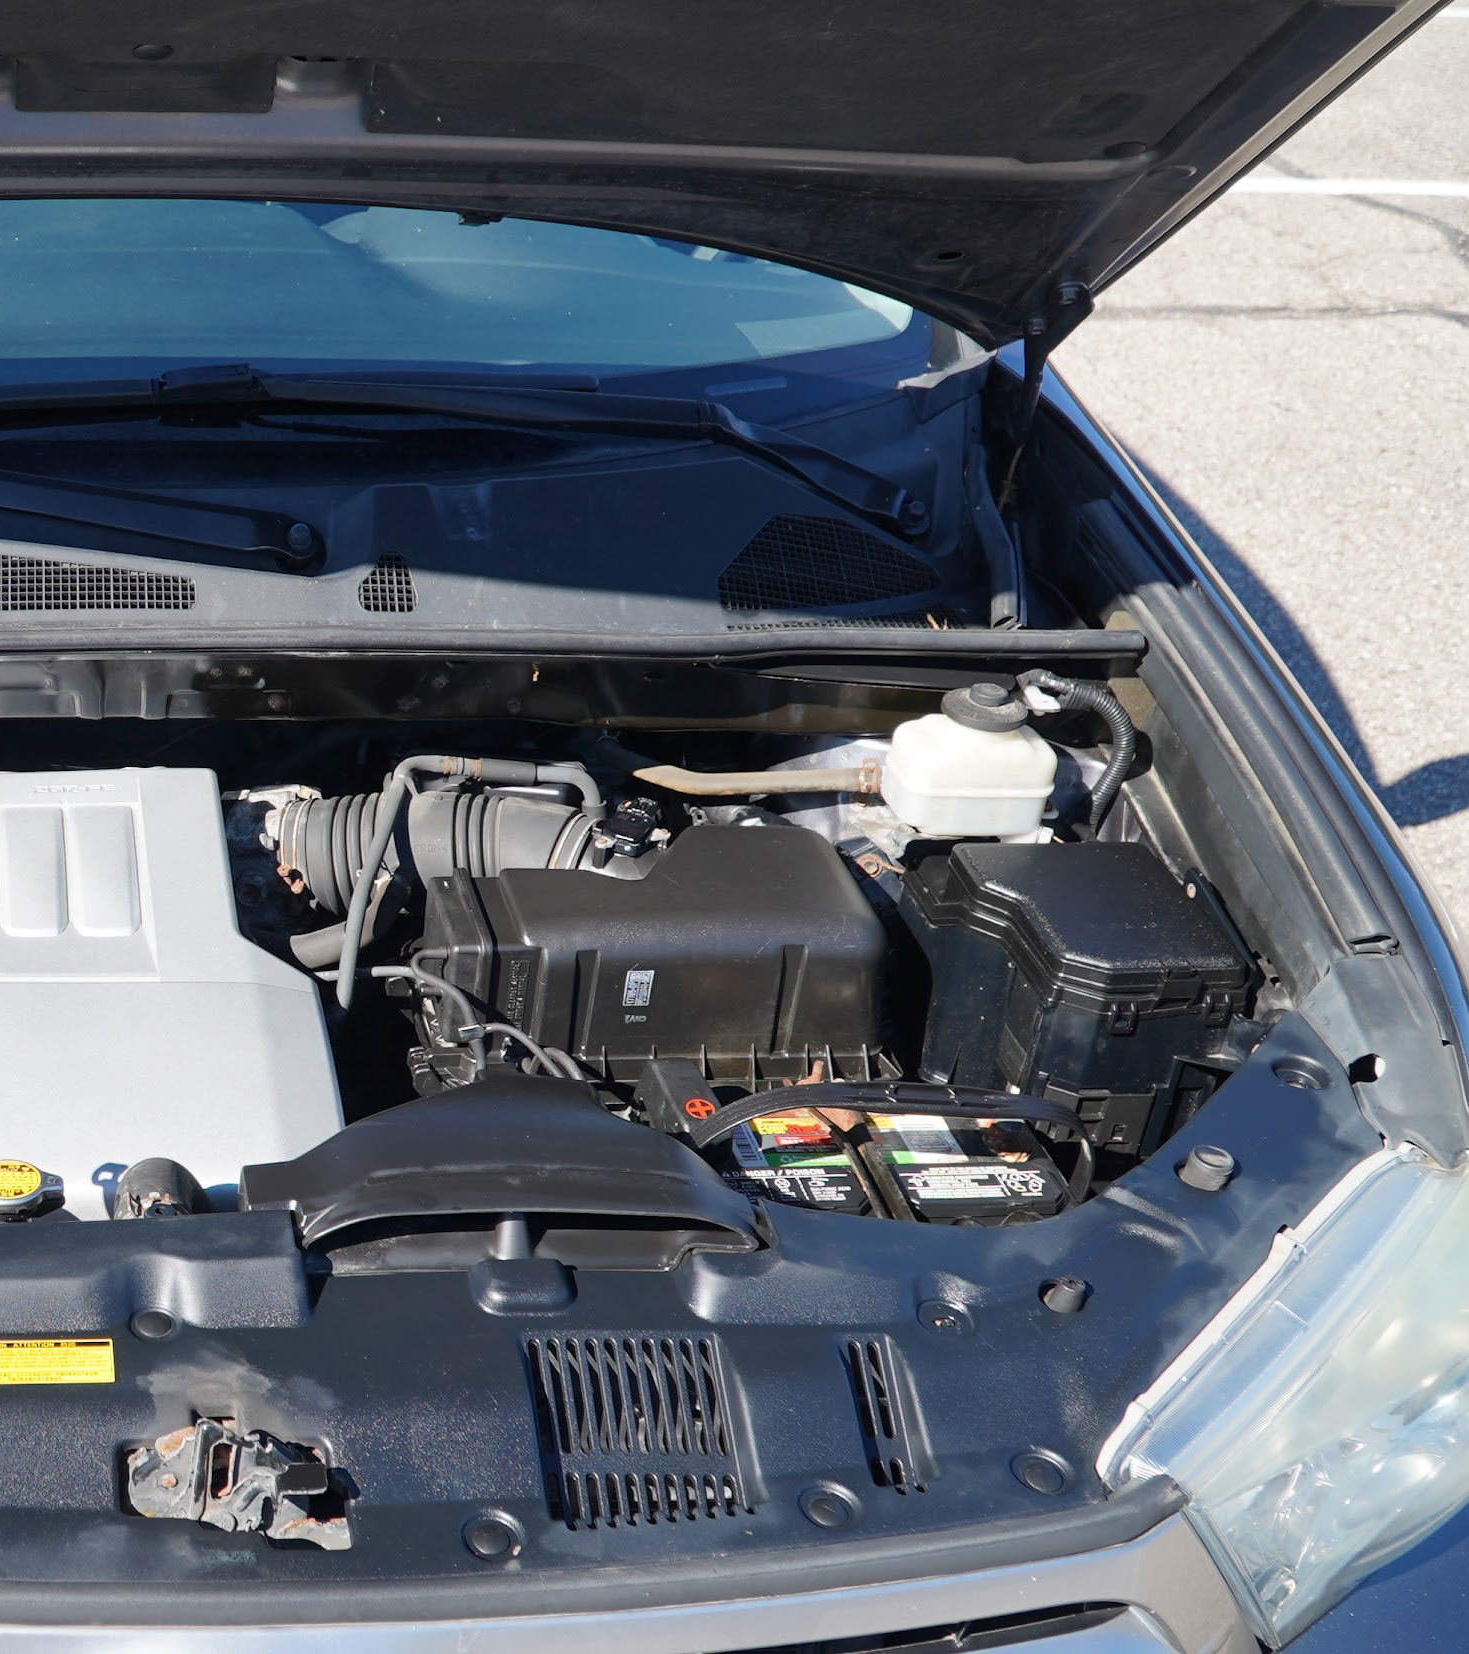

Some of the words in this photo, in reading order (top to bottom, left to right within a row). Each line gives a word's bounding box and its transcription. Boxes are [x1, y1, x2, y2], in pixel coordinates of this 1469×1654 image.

[759, 1123, 823, 1134] EverStart
[732, 1169, 776, 1177] DANGER
[784, 1168, 826, 1176] POISON
